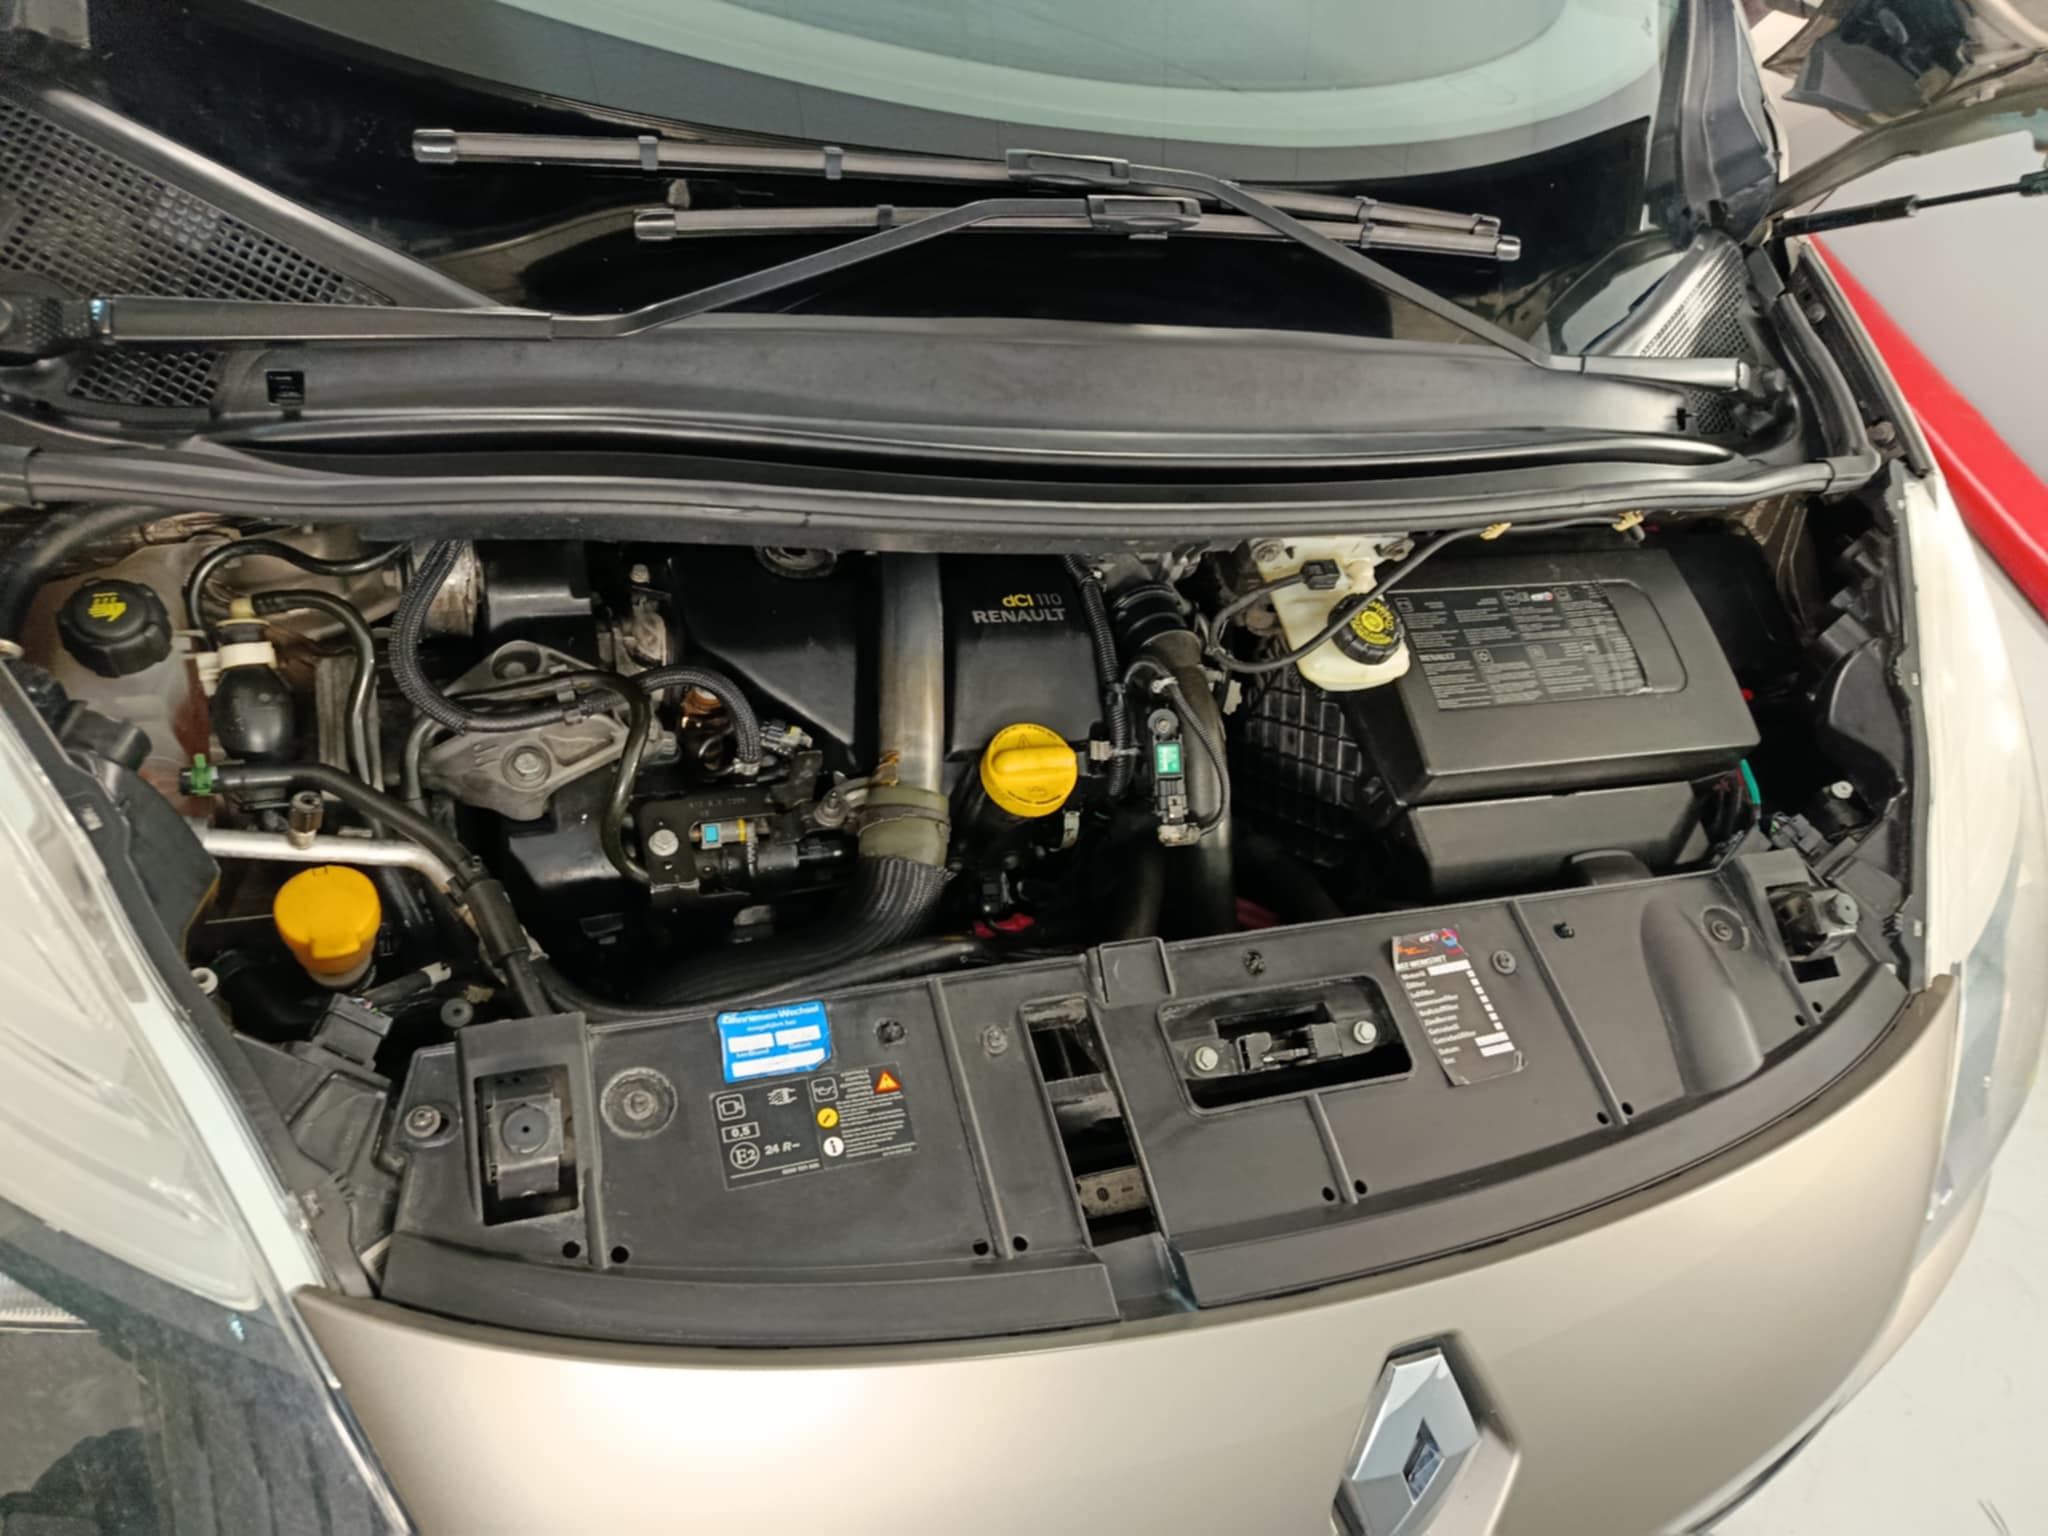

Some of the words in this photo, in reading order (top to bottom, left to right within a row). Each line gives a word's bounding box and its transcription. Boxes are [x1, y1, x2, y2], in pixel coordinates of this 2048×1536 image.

[1036, 593, 1062, 606] 110
[972, 608, 1065, 623] RENAULT
[735, 1148, 757, 1165] E2
[764, 1143, 780, 1156] 24
